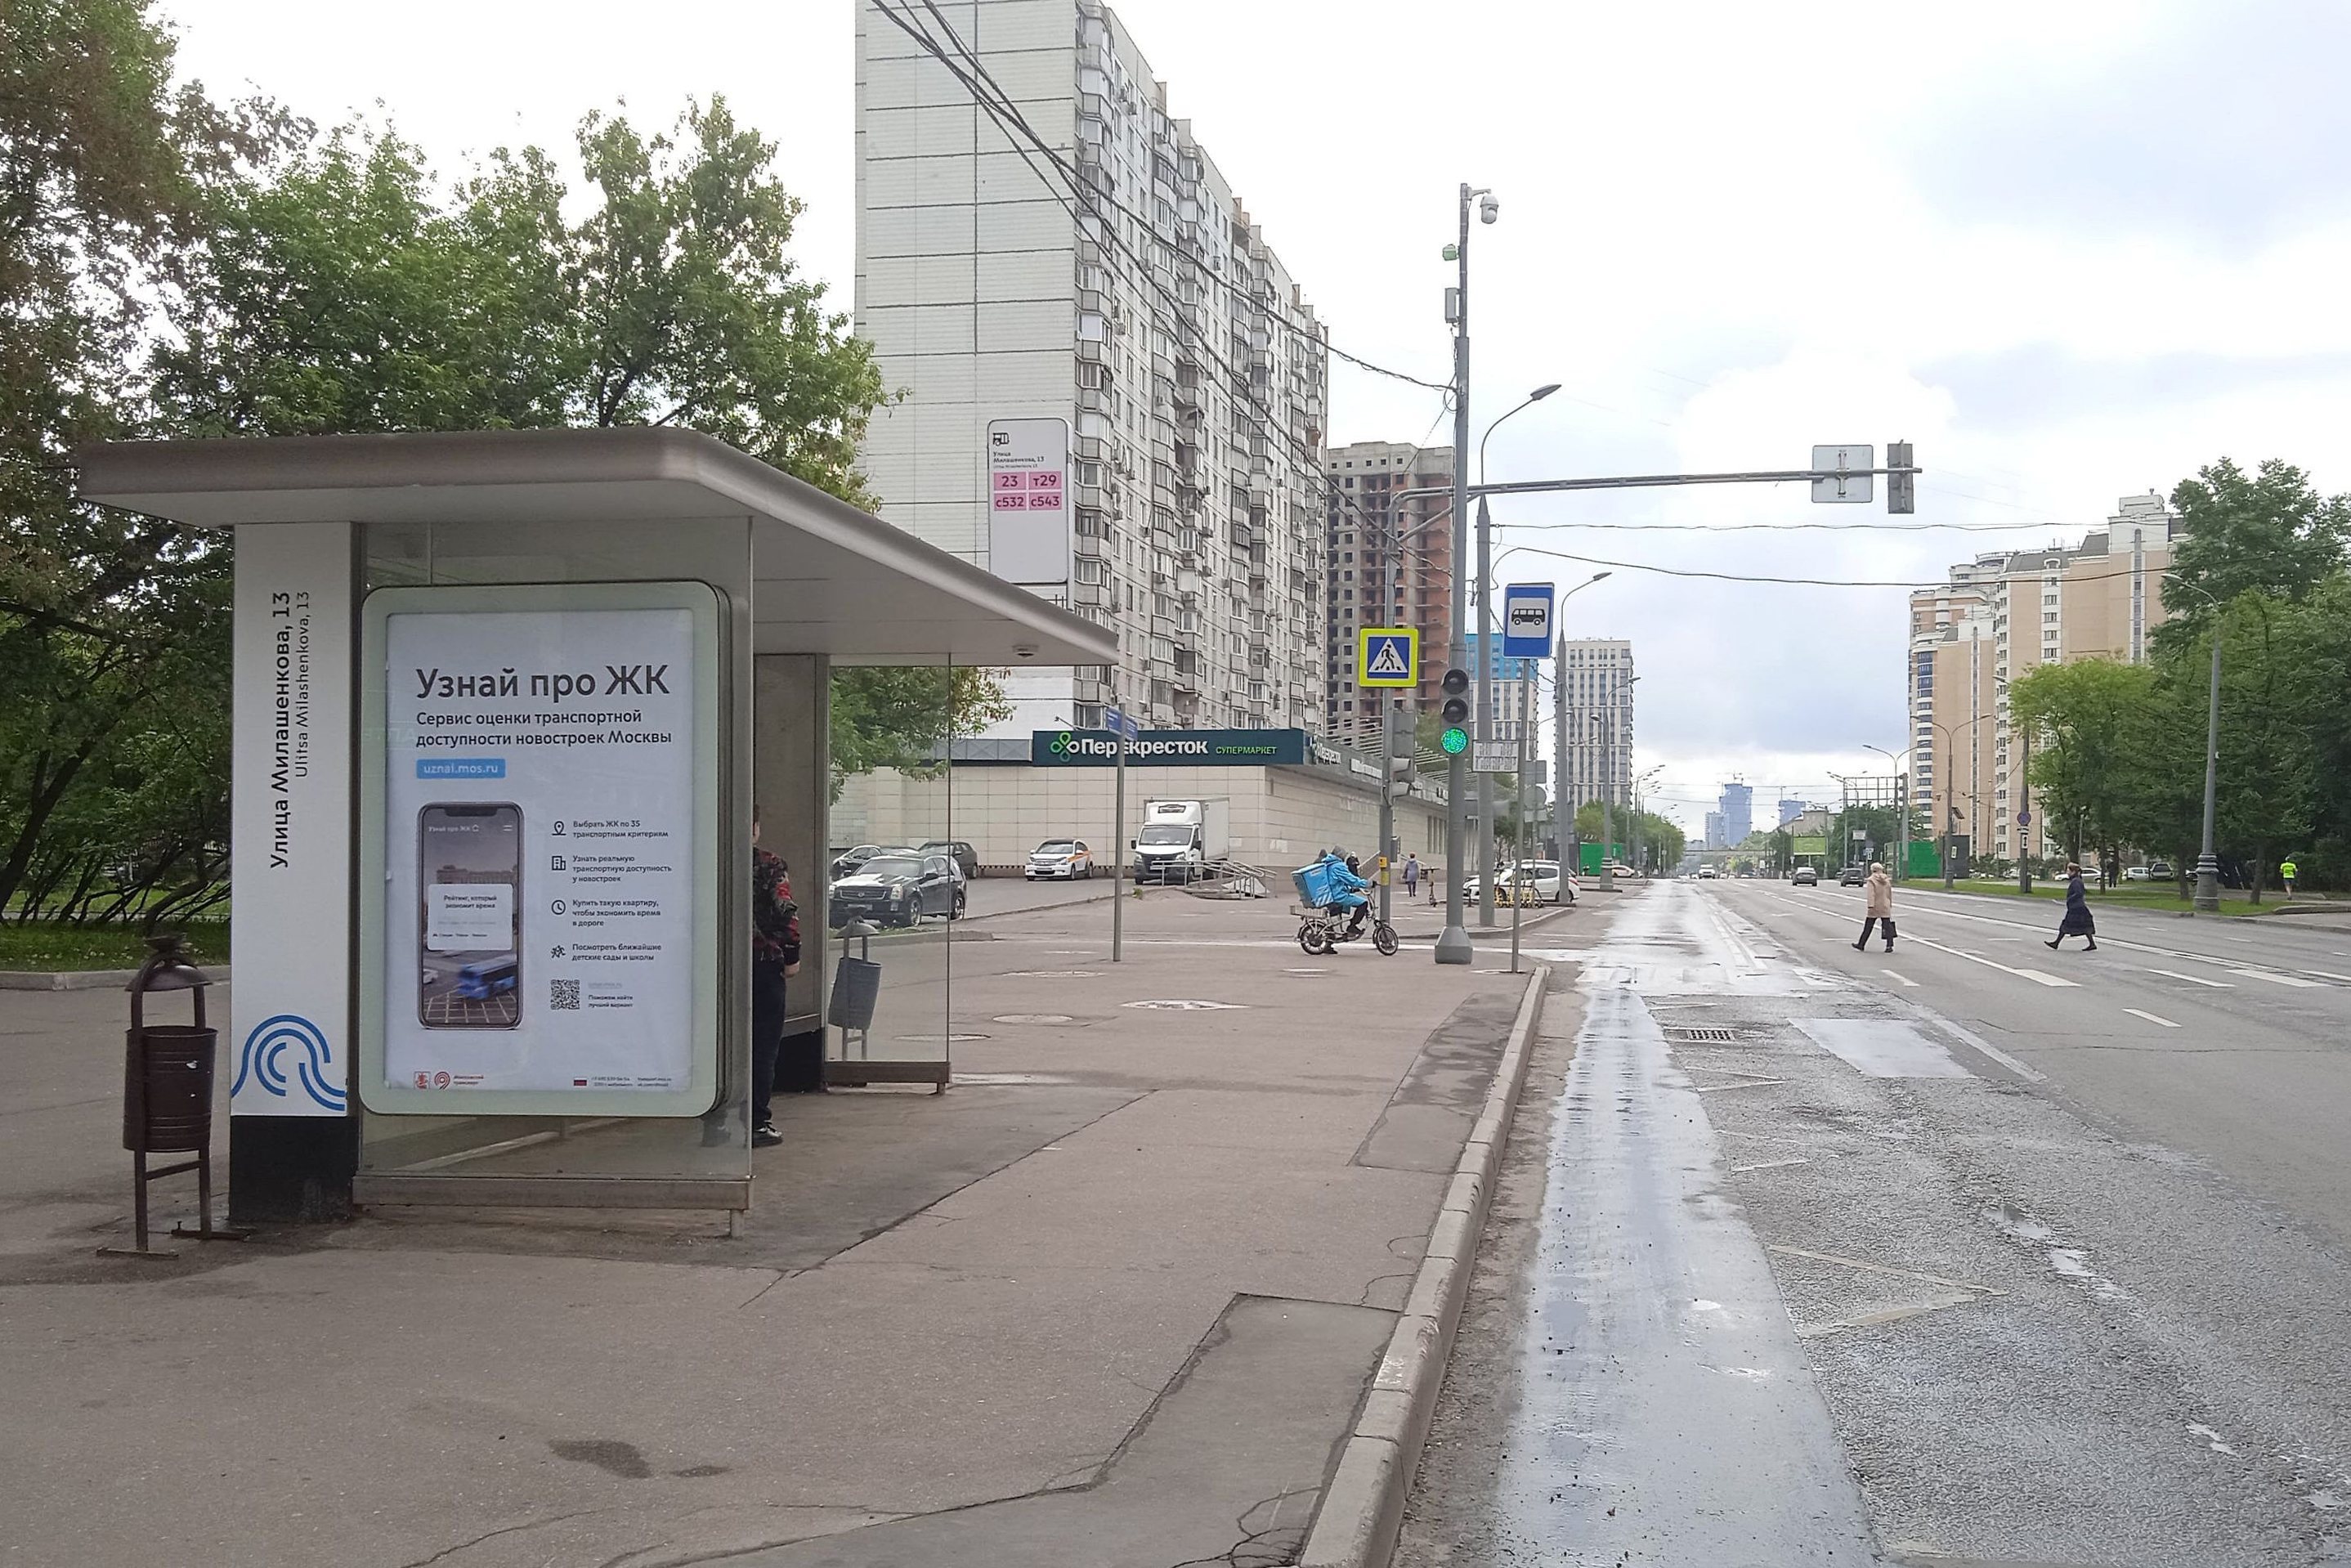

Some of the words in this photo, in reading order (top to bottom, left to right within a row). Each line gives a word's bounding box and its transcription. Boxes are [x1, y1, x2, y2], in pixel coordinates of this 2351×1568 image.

[1001, 476, 1018, 487] 23
[273, 592, 291, 618] 13
[296, 591, 310, 610] 13
[295, 613, 311, 728] Milashenkova,
[416, 667, 519, 699] Узнай
[531, 673, 597, 703] про
[605, 664, 670, 696] ЖК
[271, 624, 293, 794] Милашенкова,
[416, 711, 472, 728] Сервис
[476, 713, 531, 726] оценки
[535, 709, 642, 725] транспортной
[416, 733, 512, 748] доступности
[516, 733, 605, 746] новостроек
[607, 730, 672, 745] Москвы
[295, 732, 308, 778] Ulitsa
[1216, 745, 1277, 755] СУПЕРМАРКЕТ
[423, 763, 499, 774] uznai.mos.ru
[573, 820, 605, 829] Выбрать
[271, 799, 291, 869] Улица
[598, 855, 635, 863] реальную
[572, 899, 598, 907] Купить
[573, 943, 617, 952] Посмотреть
